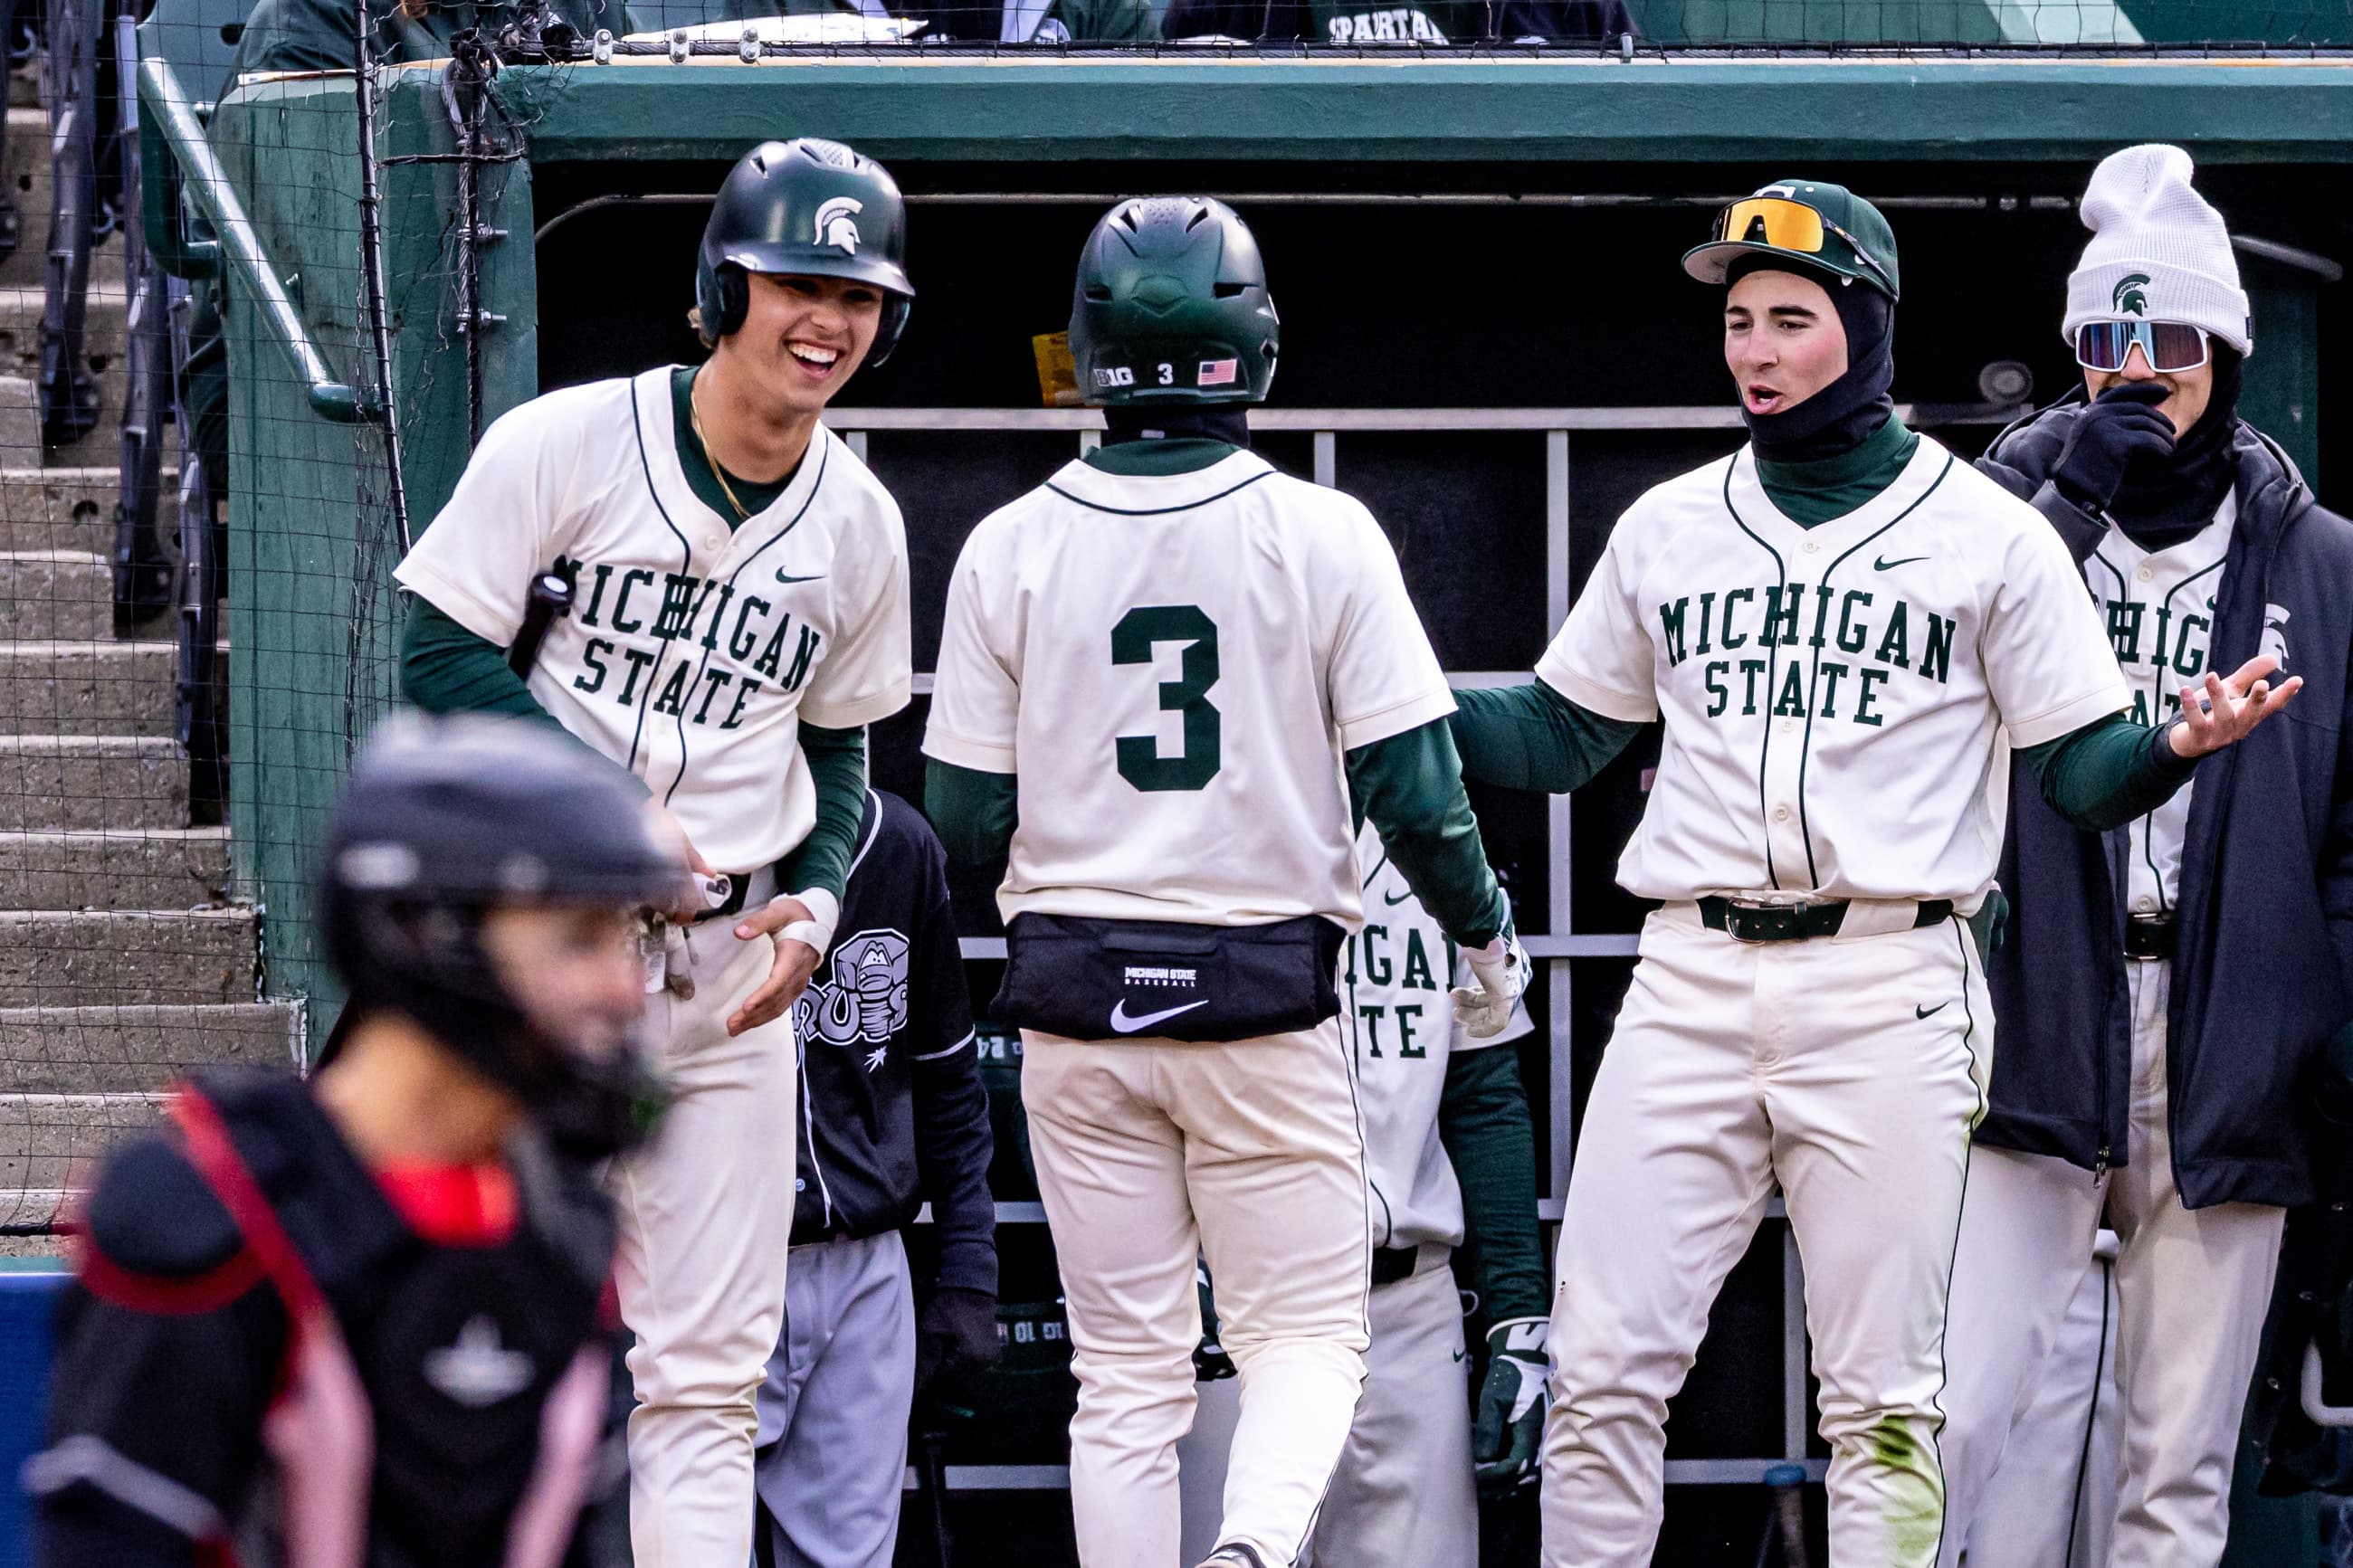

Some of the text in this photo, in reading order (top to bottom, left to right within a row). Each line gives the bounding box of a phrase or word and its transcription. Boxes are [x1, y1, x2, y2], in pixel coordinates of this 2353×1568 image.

[1157, 363, 1174, 385] 3
[1659, 583, 1957, 683] MICHIGAN
[574, 638, 762, 729] STATE
[1110, 604, 1222, 792] 3
[1705, 660, 1890, 727] STATE
[1125, 966, 1196, 980] MICHIGAN STATE
[1125, 978, 1196, 987] BASEBALL
